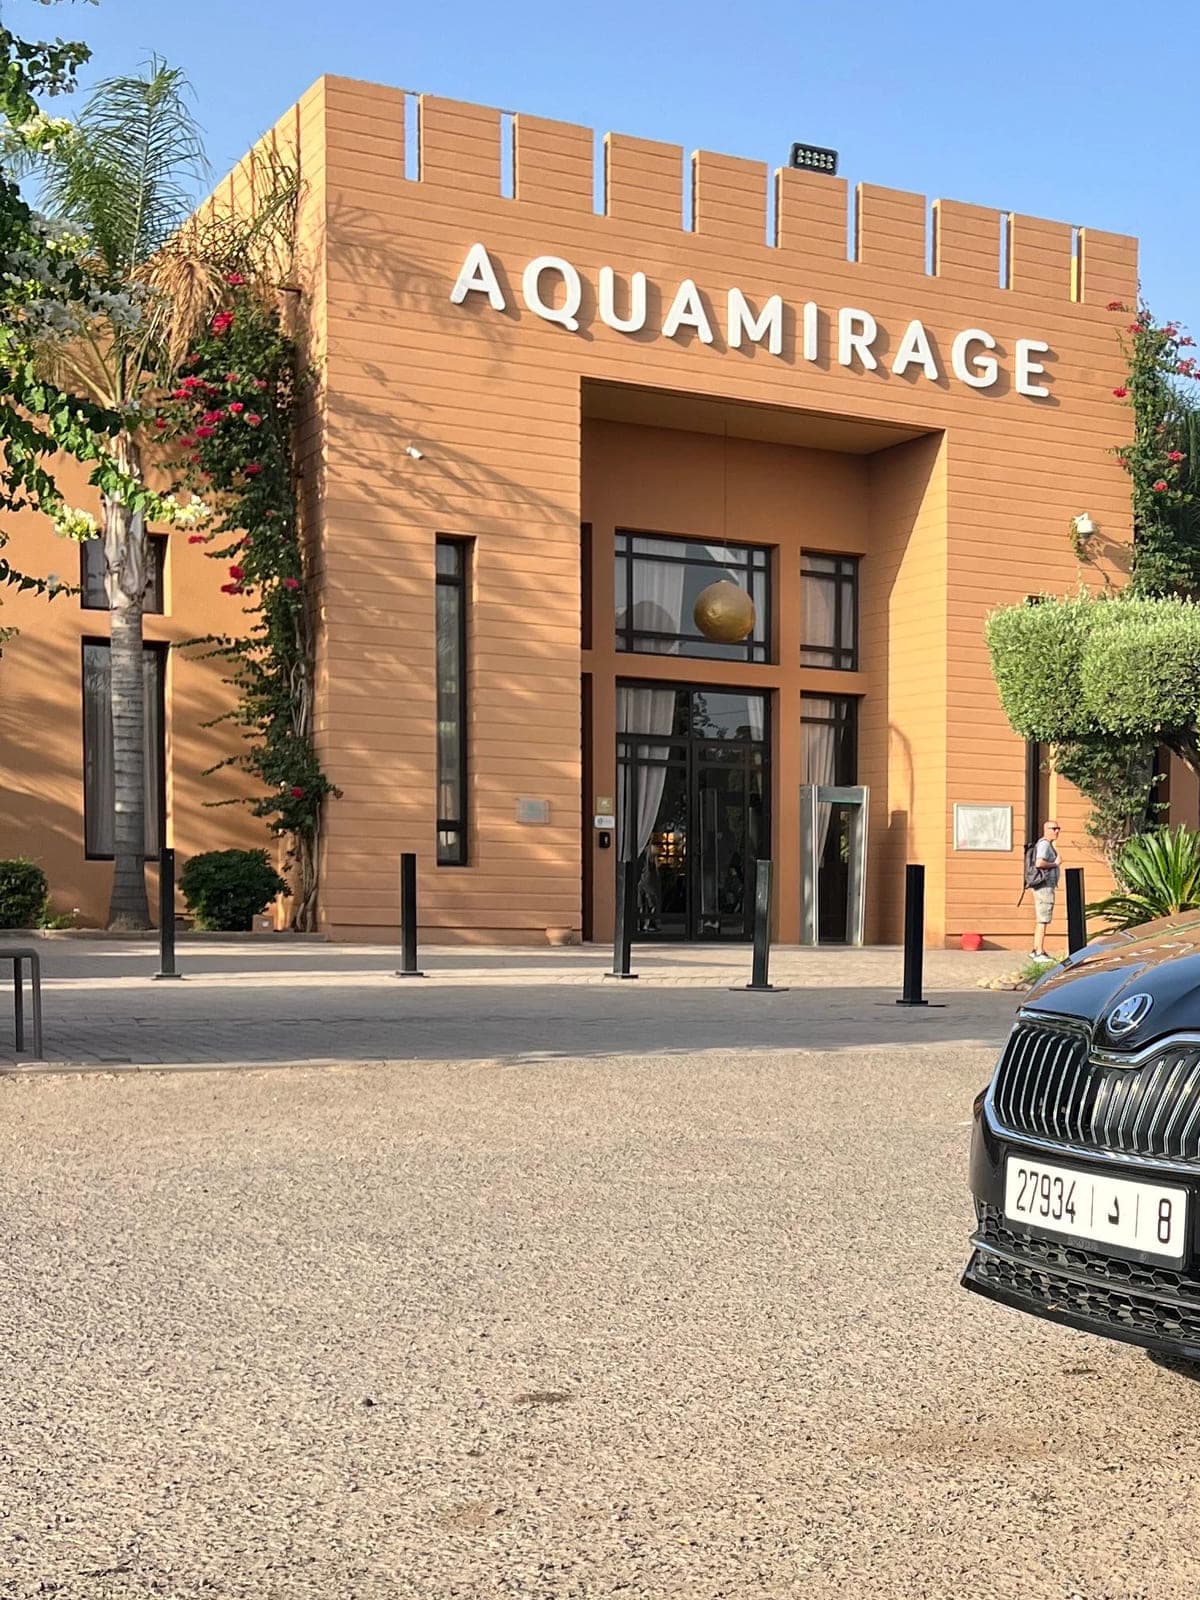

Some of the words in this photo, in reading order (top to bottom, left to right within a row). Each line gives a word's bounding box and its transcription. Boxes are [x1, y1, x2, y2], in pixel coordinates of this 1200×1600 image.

[450, 242, 1050, 398] AQUAMIRAGE
[1016, 1168, 1076, 1224] 27934
[1157, 1198, 1172, 1244] 8
